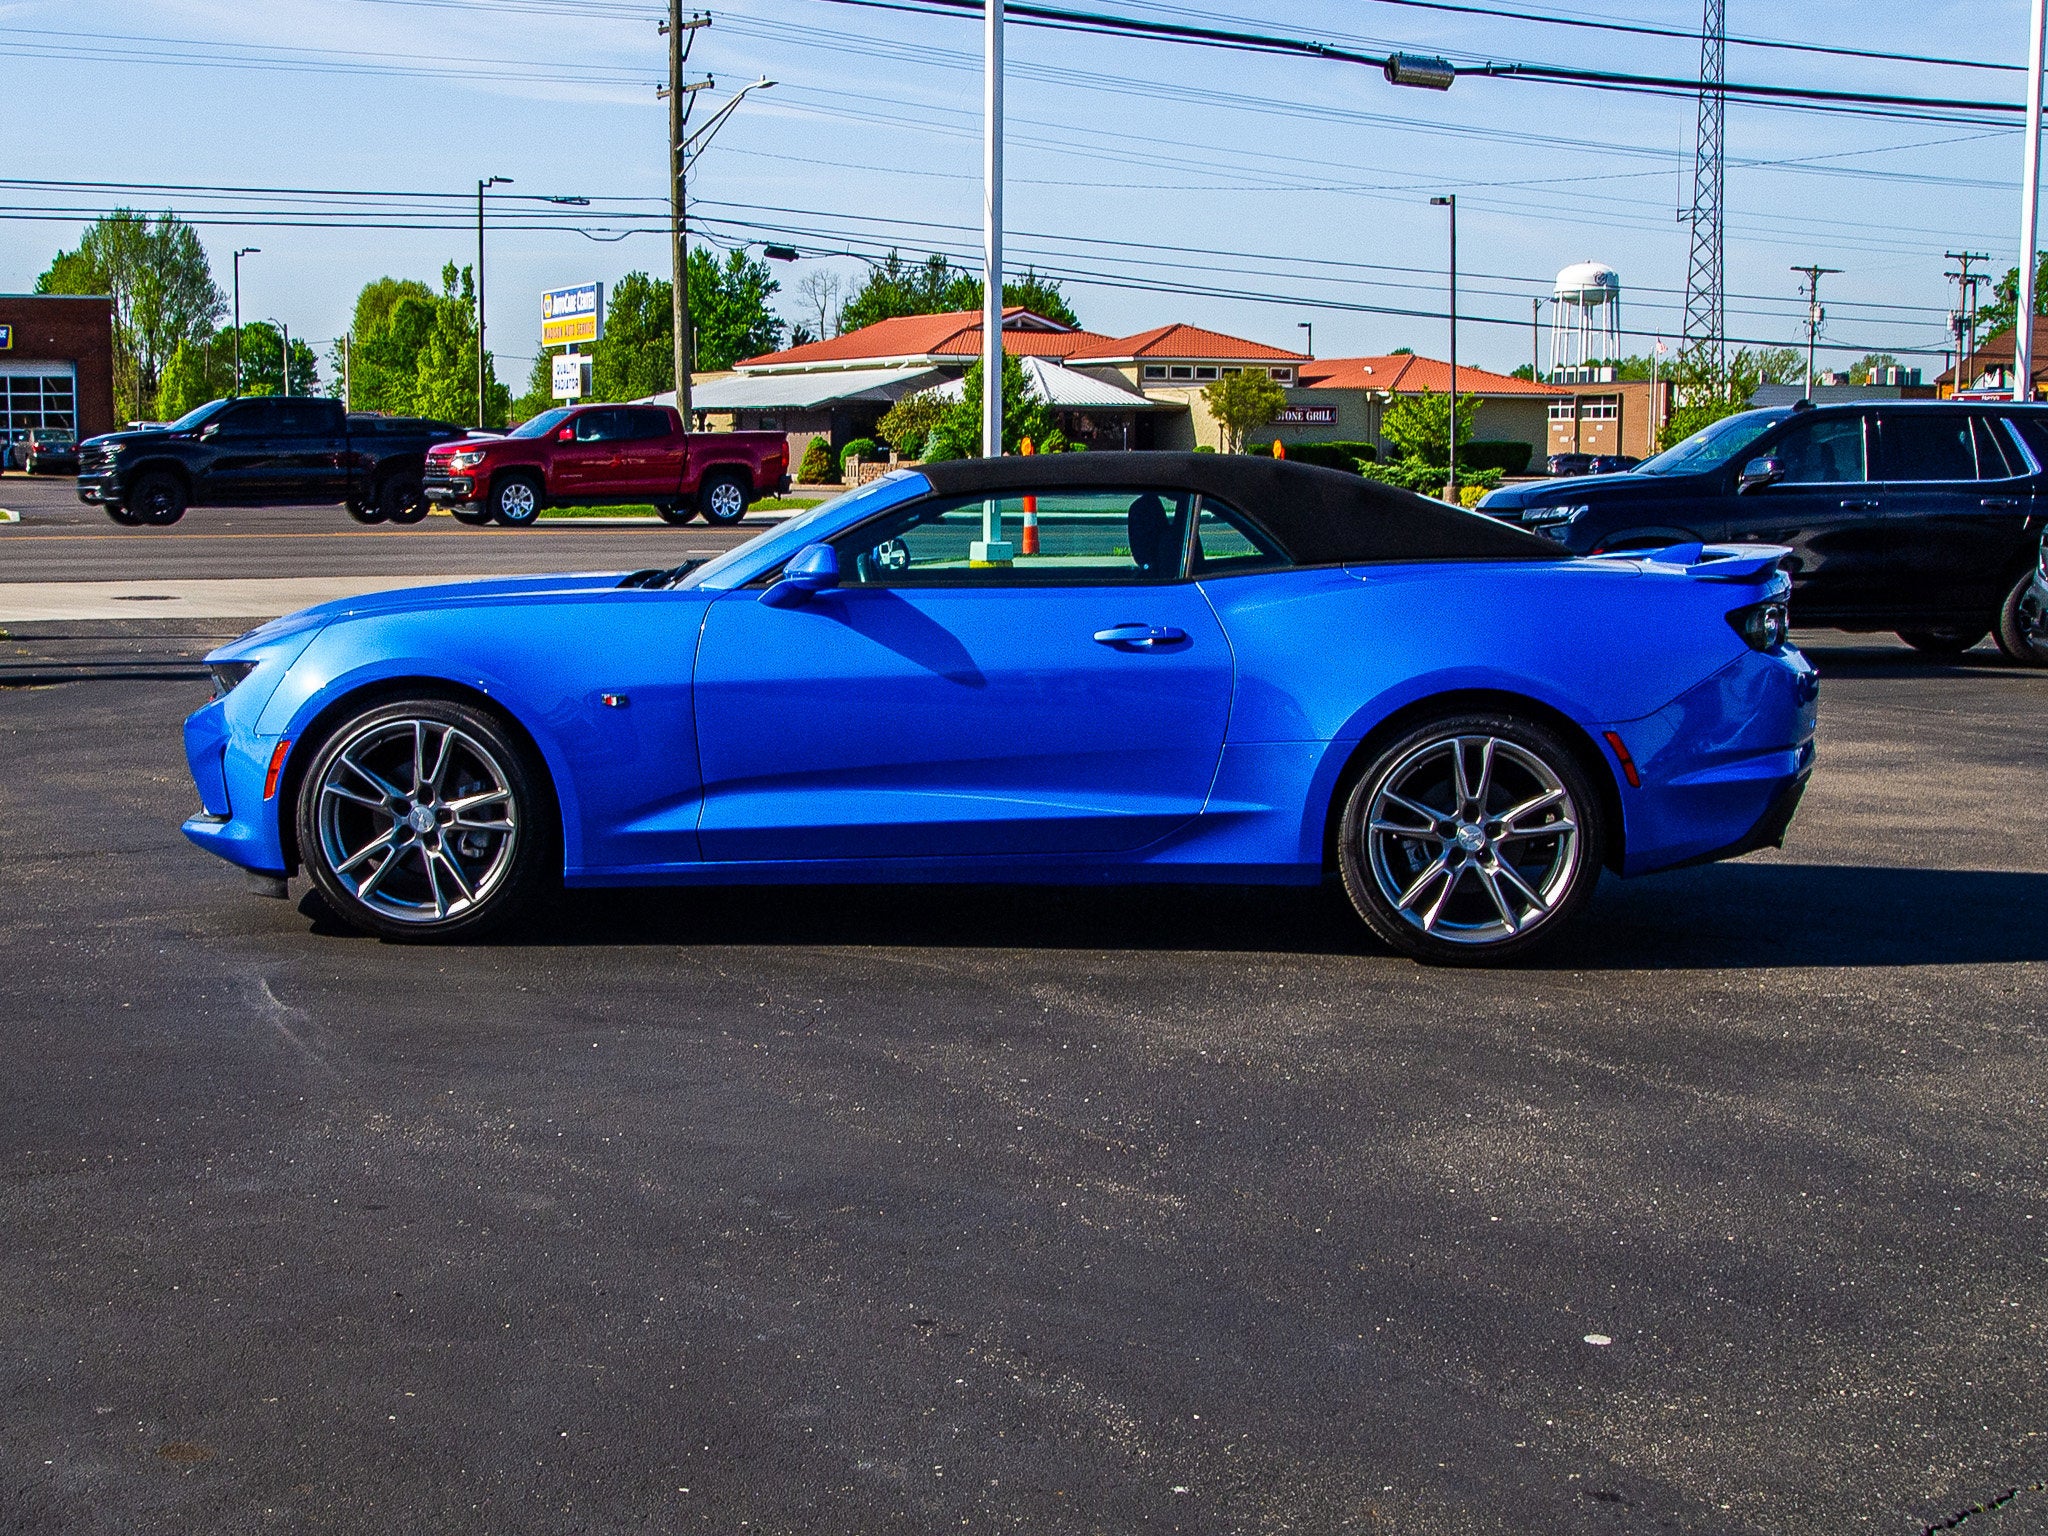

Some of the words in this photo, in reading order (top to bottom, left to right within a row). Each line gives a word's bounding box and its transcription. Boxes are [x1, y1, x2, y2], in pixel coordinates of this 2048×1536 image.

[544, 326, 562, 339] MADISON
[565, 324, 575, 337] AUTO
[577, 322, 595, 336] SERVICE
[557, 362, 577, 375] QUALITY
[555, 378, 579, 390] RADIATOR
[1306, 410, 1332, 421] GRILL
